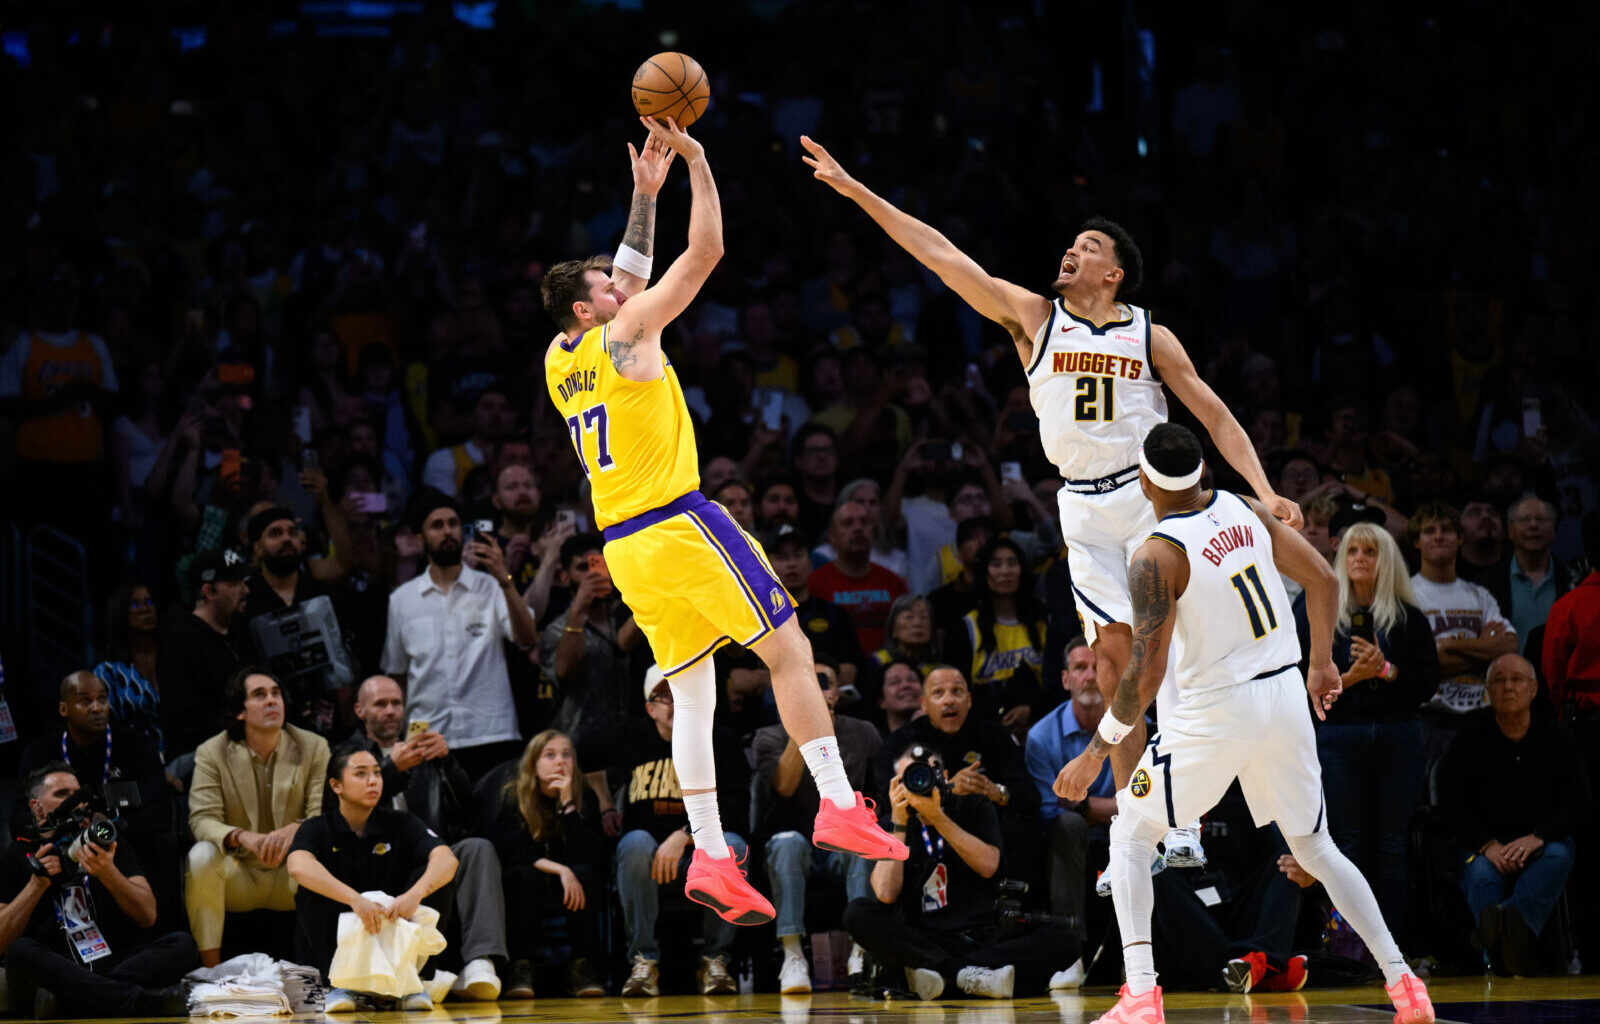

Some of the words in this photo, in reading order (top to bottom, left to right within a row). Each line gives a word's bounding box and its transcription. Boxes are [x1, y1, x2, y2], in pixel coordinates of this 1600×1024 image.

[557, 366, 597, 403] DONČIĆ
[1053, 352, 1143, 380] NUGGETS
[1075, 376, 1114, 422] 21
[566, 401, 617, 480] 77
[1202, 524, 1254, 567] BROWN
[1230, 562, 1278, 640] 11
